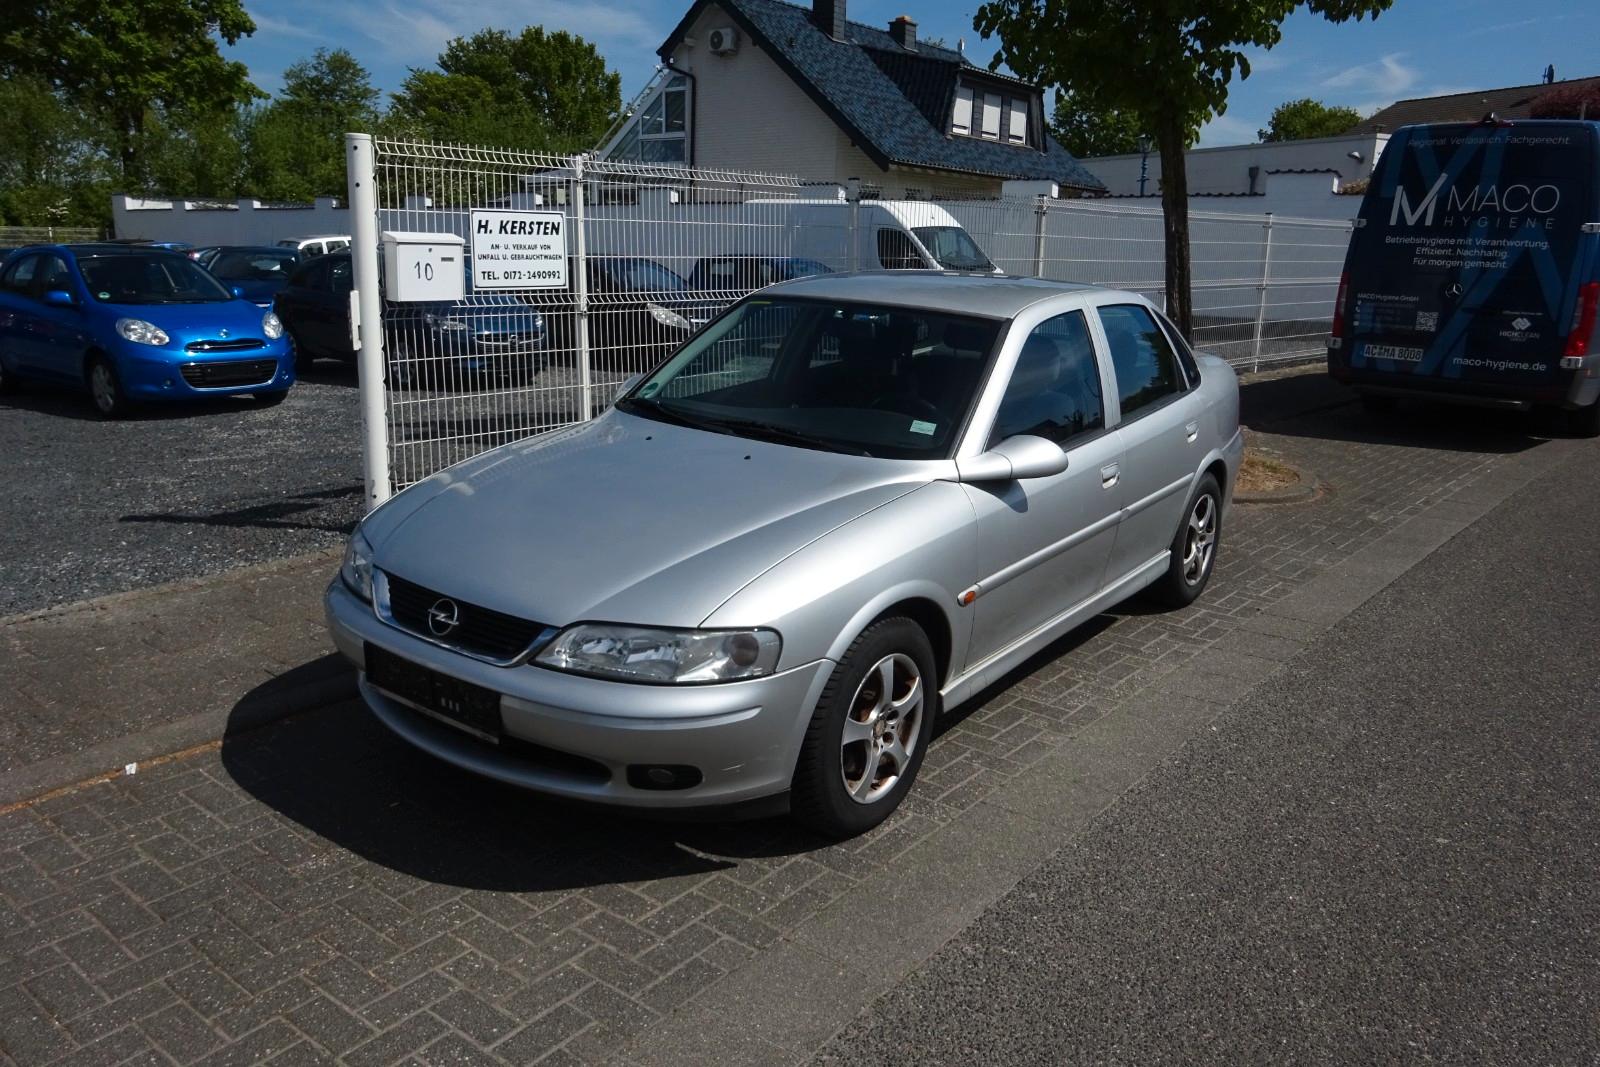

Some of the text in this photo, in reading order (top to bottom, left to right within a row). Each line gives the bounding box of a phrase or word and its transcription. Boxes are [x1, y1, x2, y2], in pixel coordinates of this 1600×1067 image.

[1447, 184, 1560, 214] MACO
[477, 219, 561, 236] H. KERSTEN
[1443, 215, 1556, 230] HYGIENE
[512, 243, 539, 251] VERKAUF
[1385, 235, 1550, 250] Betriebshygiene mit Verantwortung.
[477, 253, 500, 261] UNFALL
[1415, 246, 1509, 259] Effizient. Nachhaltig.
[1413, 257, 1508, 269] Für morgen gemacht.
[414, 261, 434, 281] 10
[481, 270, 561, 280] TEL. 0172-2490992
[1453, 356, 1547, 372] maco-hygiene.de
